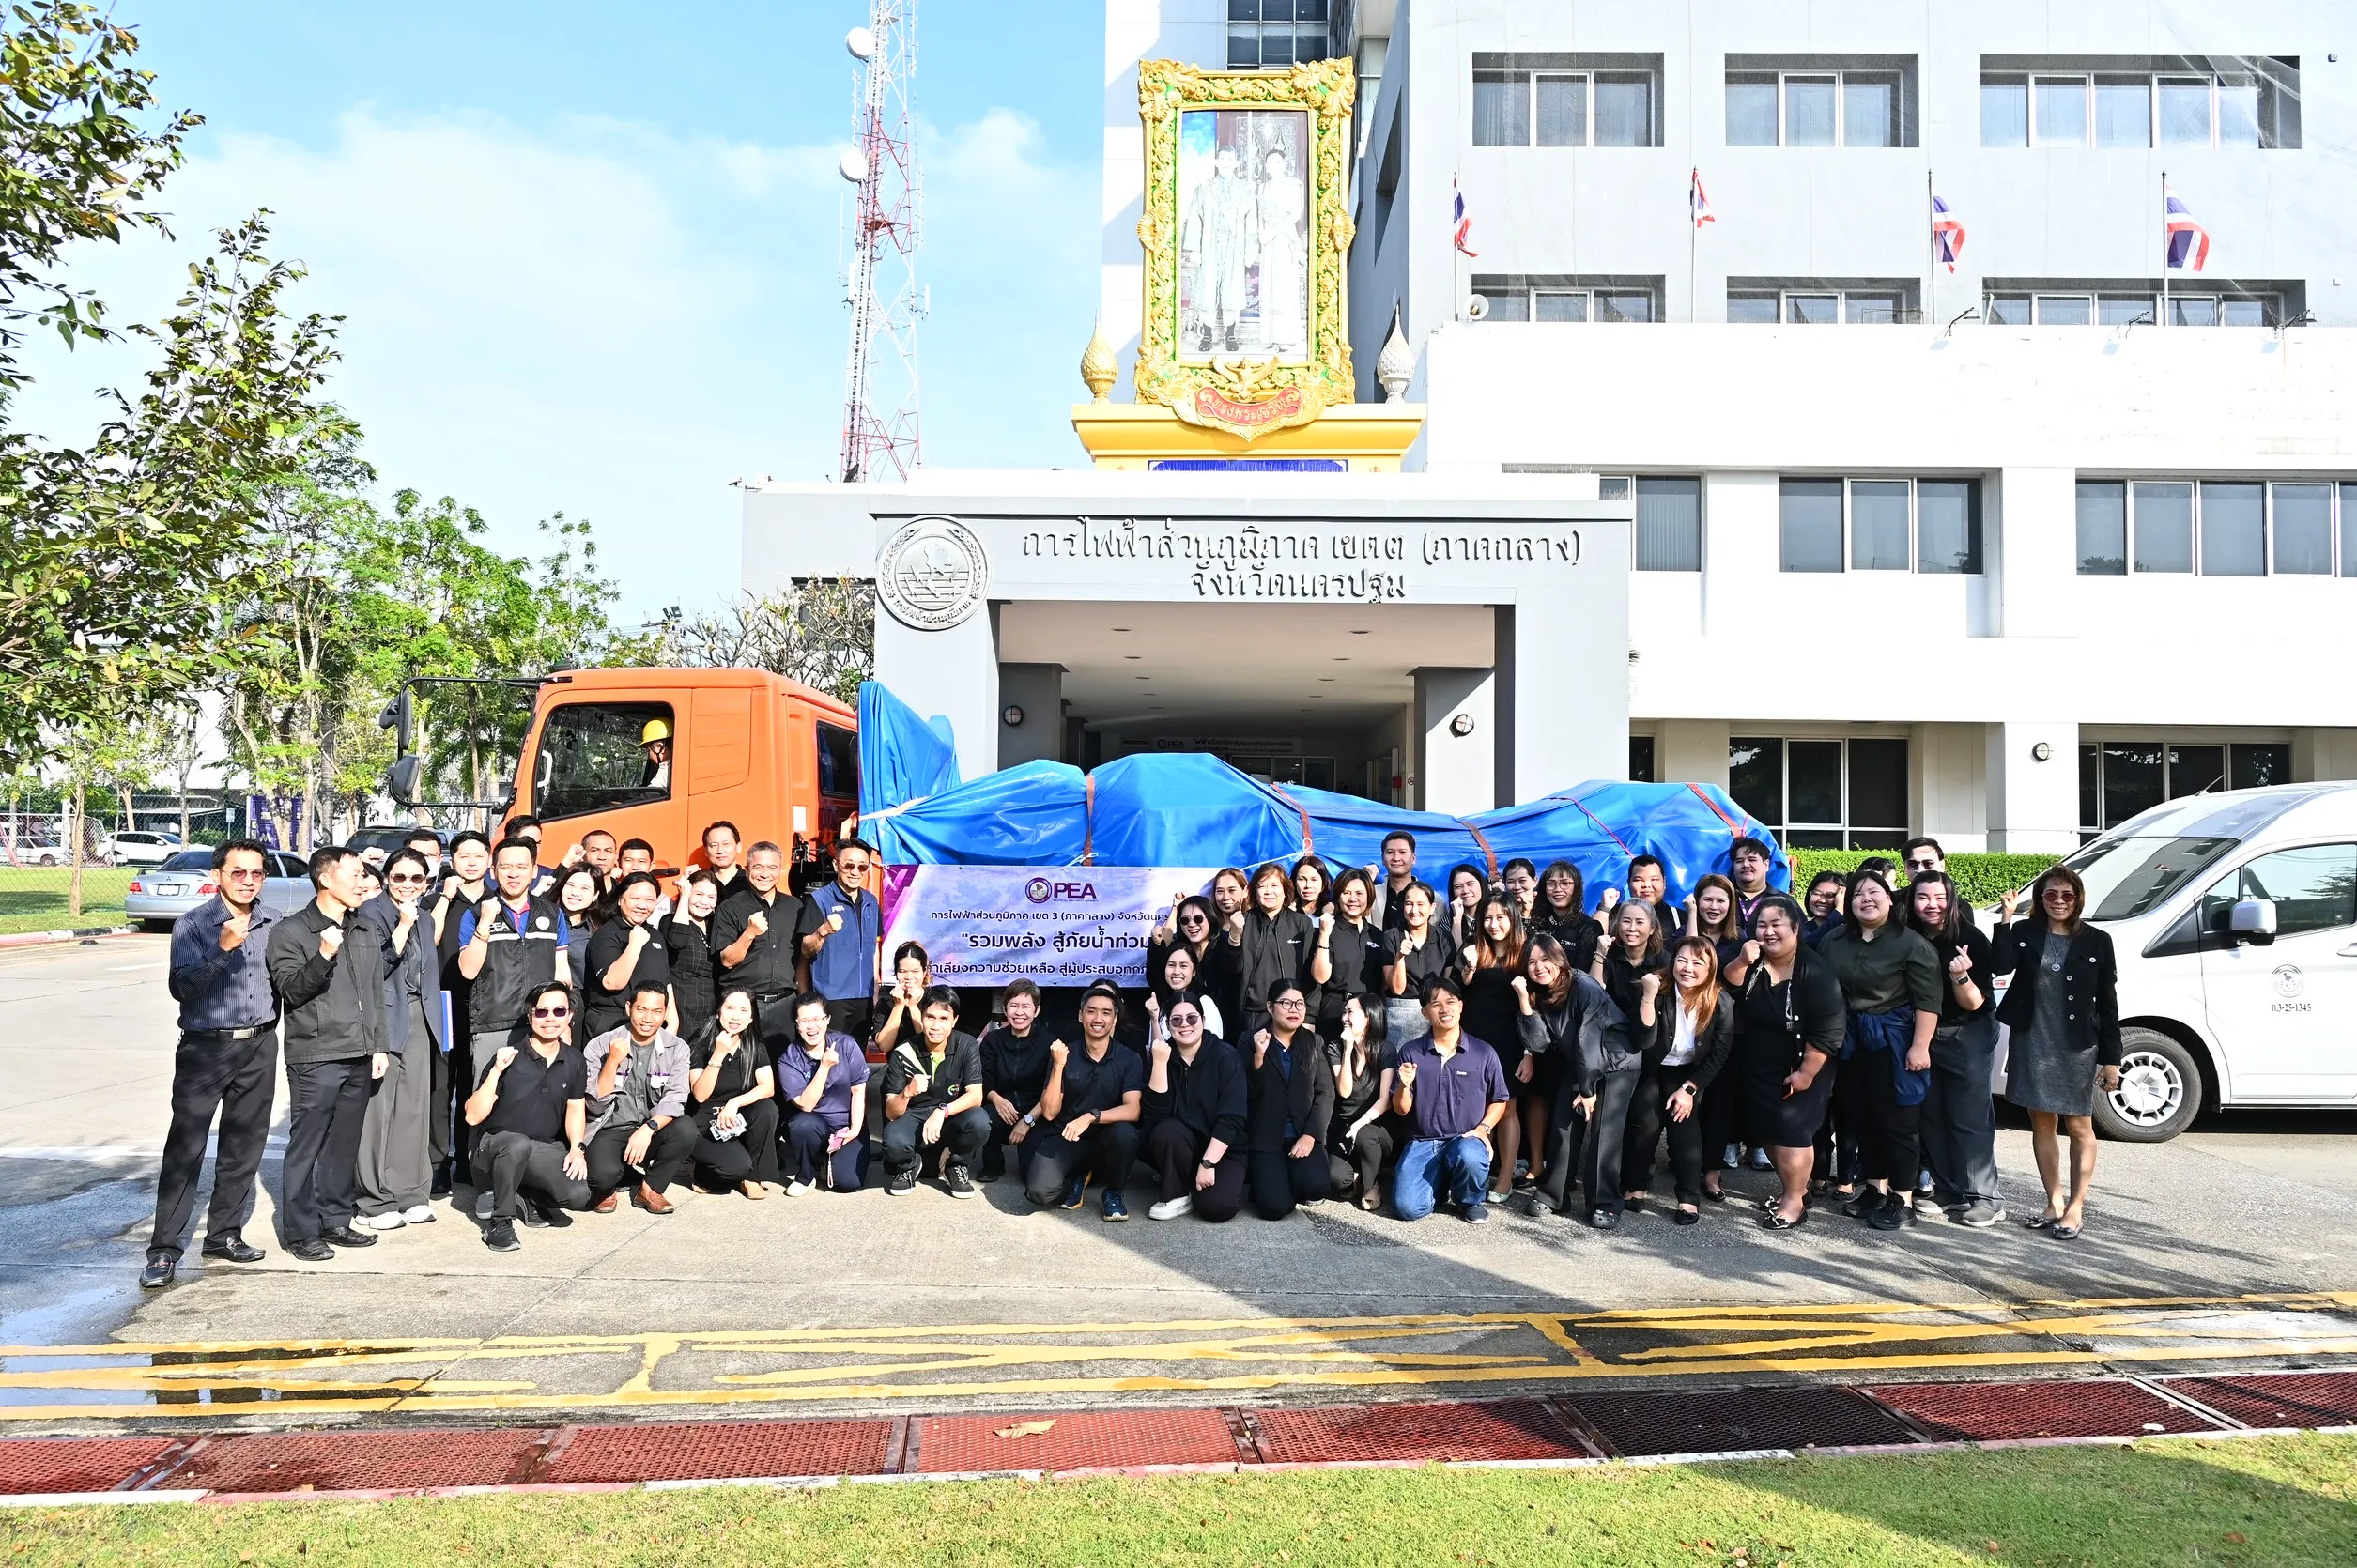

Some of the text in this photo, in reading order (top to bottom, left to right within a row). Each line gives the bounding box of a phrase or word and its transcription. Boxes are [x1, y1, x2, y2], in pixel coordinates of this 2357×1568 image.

[1024, 517, 1320, 569] การไฟฟ้าส่วนภูมิภาค
[1423, 530, 1582, 566] (ภาคกลาง)
[1191, 560, 1406, 605] จังหวัดนครปฐม
[1054, 883, 1097, 899] PEA
[931, 909, 1029, 922] การไฟฟ้าส่วนภูมิภาค
[1032, 912, 1049, 920] เขต
[1052, 912, 1058, 920] 3
[1061, 911, 1115, 922] (ภาคกลาง)
[962, 931, 1046, 948] "รวมพลัง
